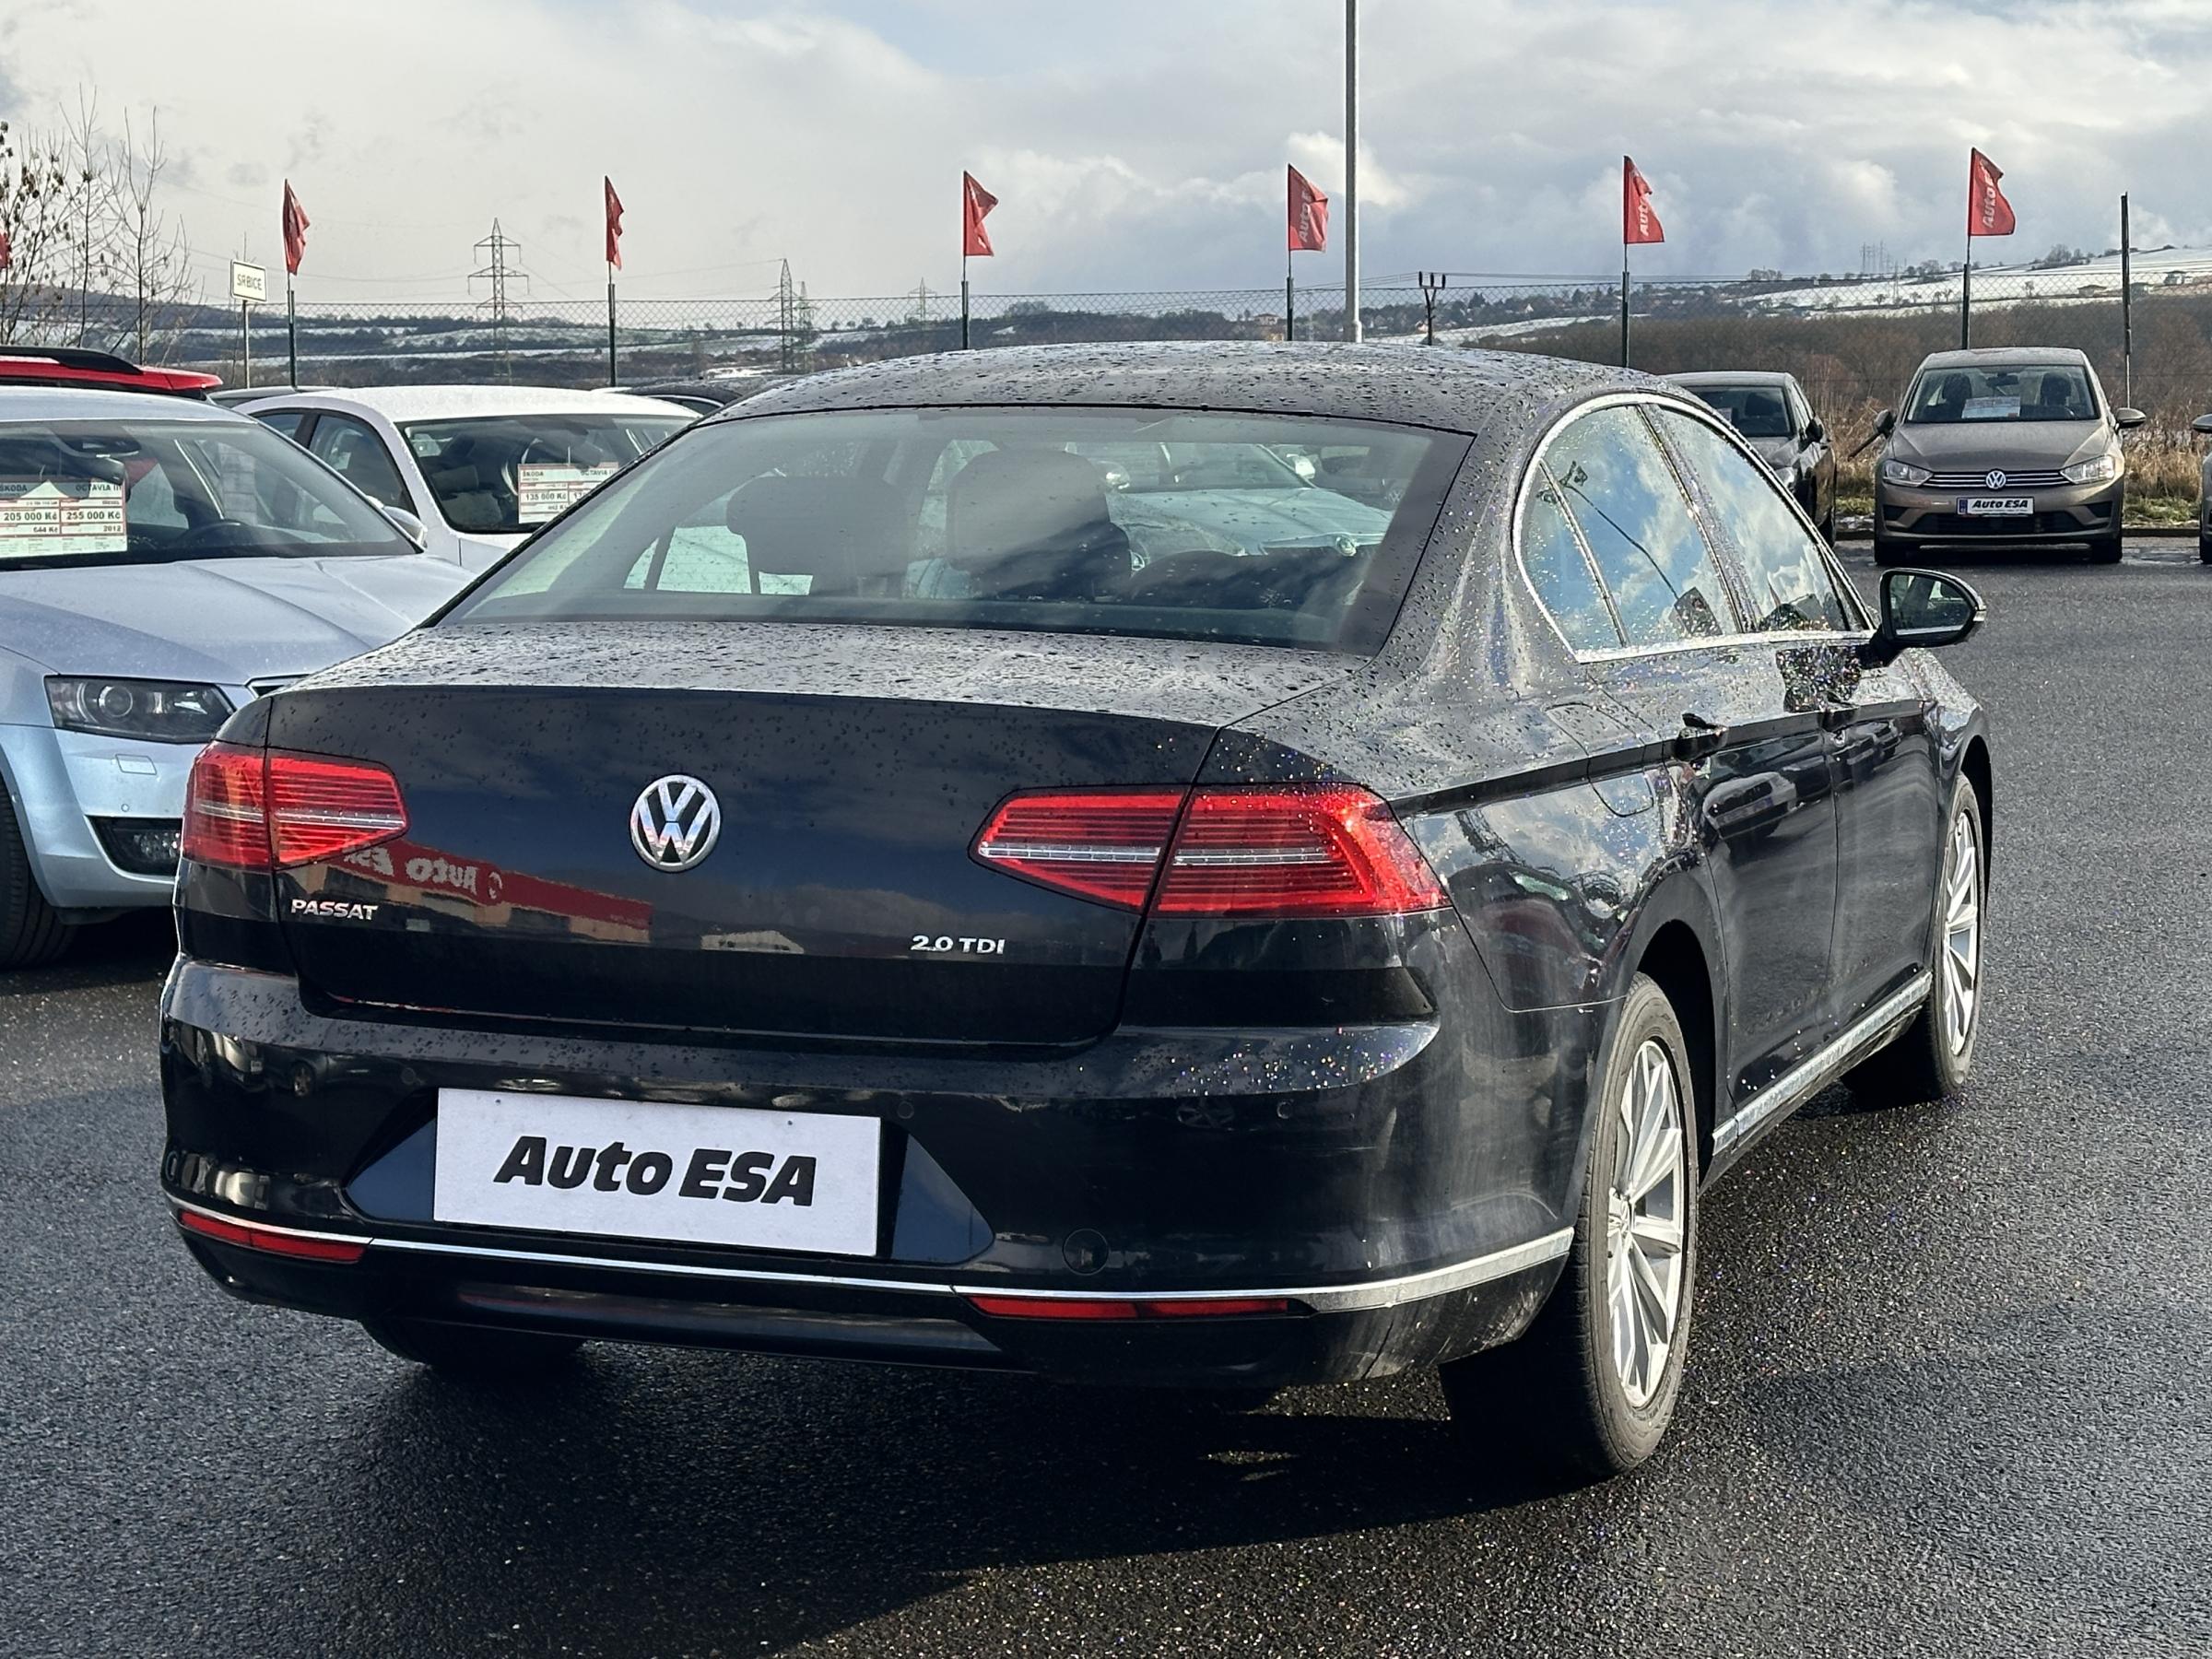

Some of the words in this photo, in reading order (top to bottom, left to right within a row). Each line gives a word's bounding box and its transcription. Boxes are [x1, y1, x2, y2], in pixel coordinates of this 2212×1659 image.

[1971, 500, 2004, 509] Auto
[2005, 500, 2029, 509] ESA
[4, 512, 21, 521] 205
[24, 512, 41, 521] 000
[45, 512, 57, 520] Kč
[87, 511, 105, 520] 000
[108, 511, 121, 519] Kč
[291, 899, 379, 921] PASSAT
[959, 937, 1006, 954] TDI
[493, 1135, 673, 1195] Auto
[678, 1147, 817, 1207] ESA
